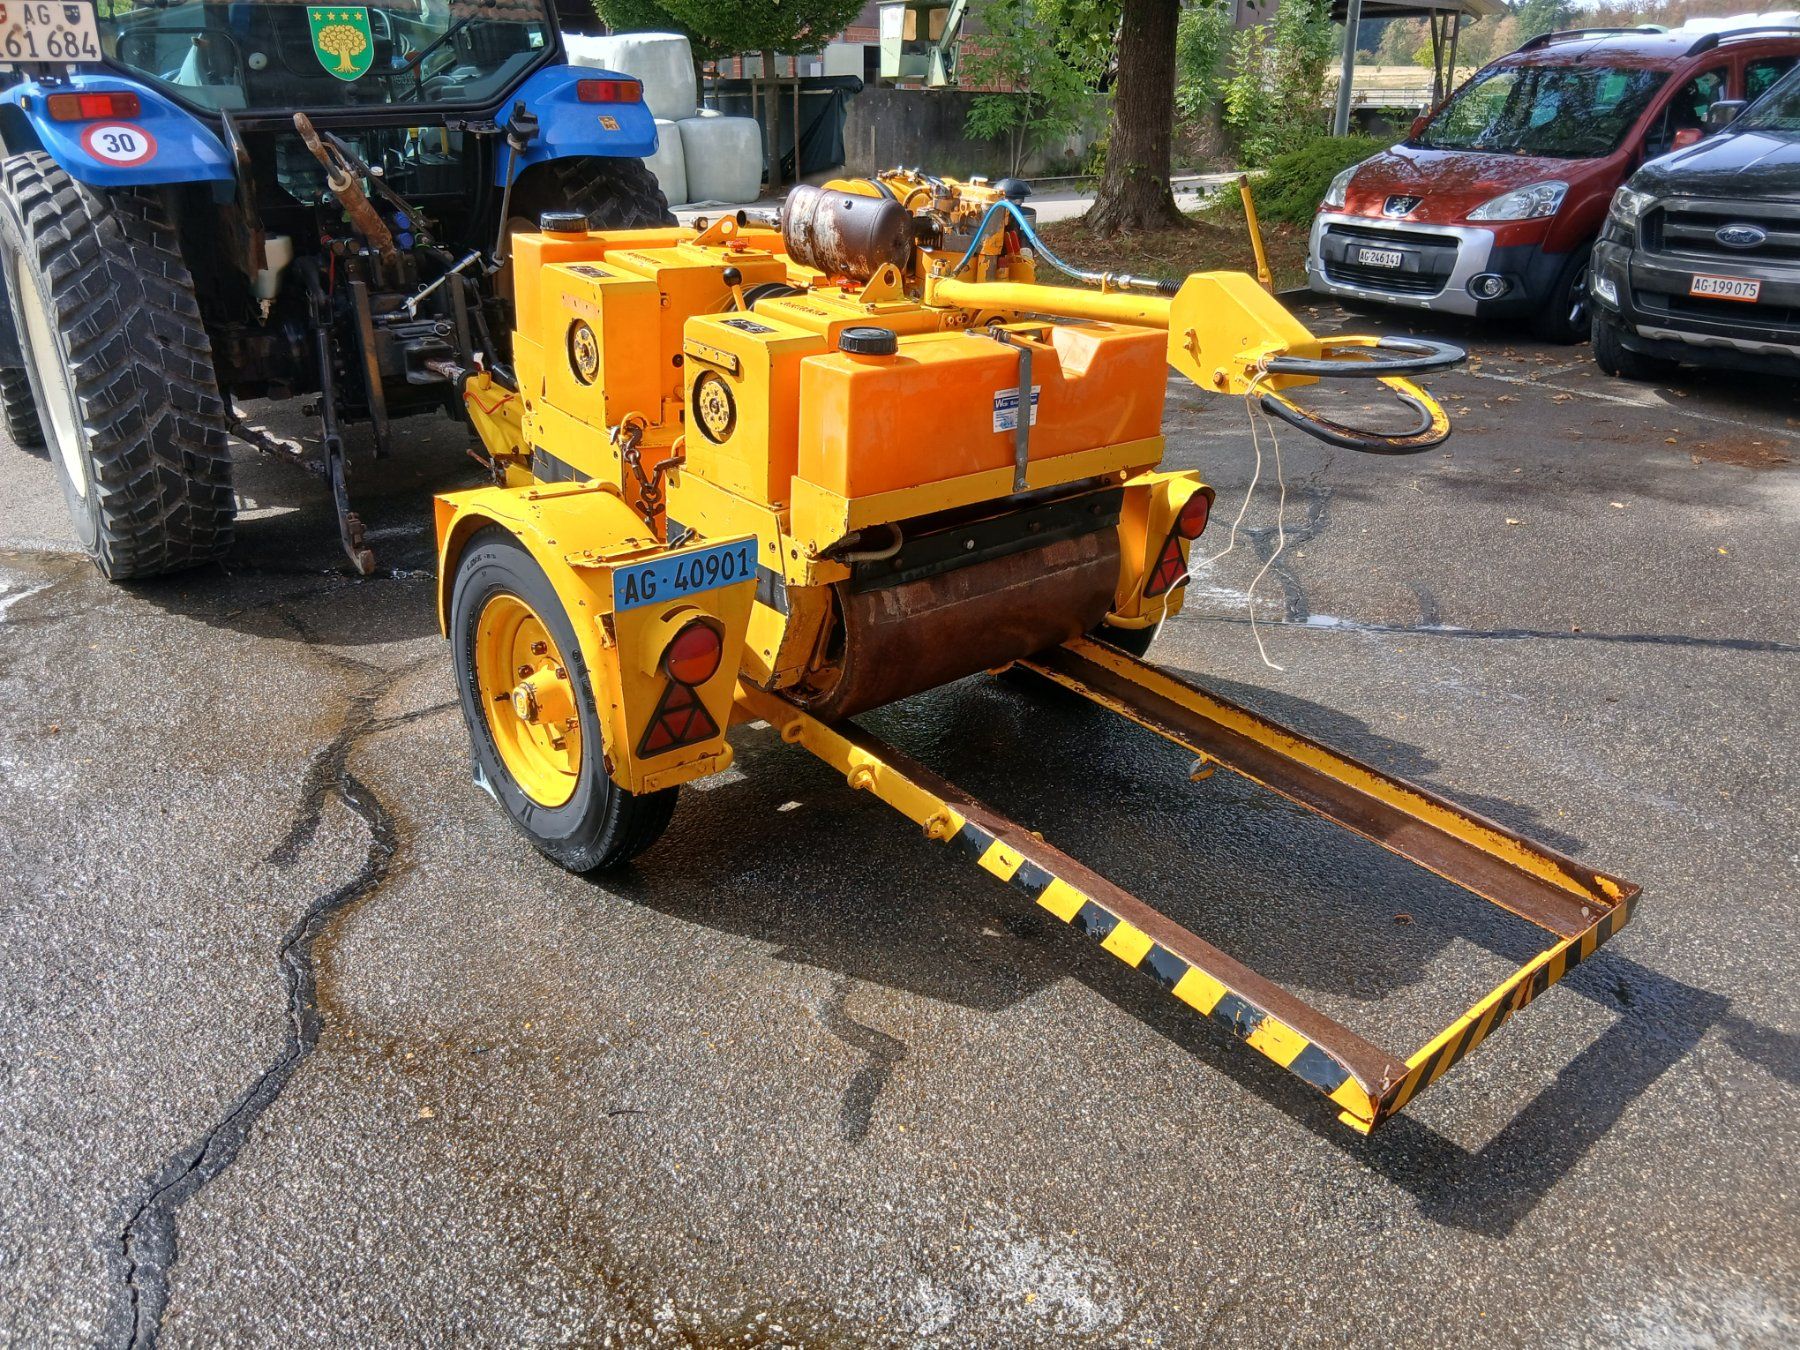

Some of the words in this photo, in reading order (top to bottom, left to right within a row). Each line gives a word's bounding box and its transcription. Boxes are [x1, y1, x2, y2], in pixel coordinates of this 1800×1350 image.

[24, 4, 51, 25] AG
[0, 30, 39, 58] 61
[103, 134, 136, 153] 30
